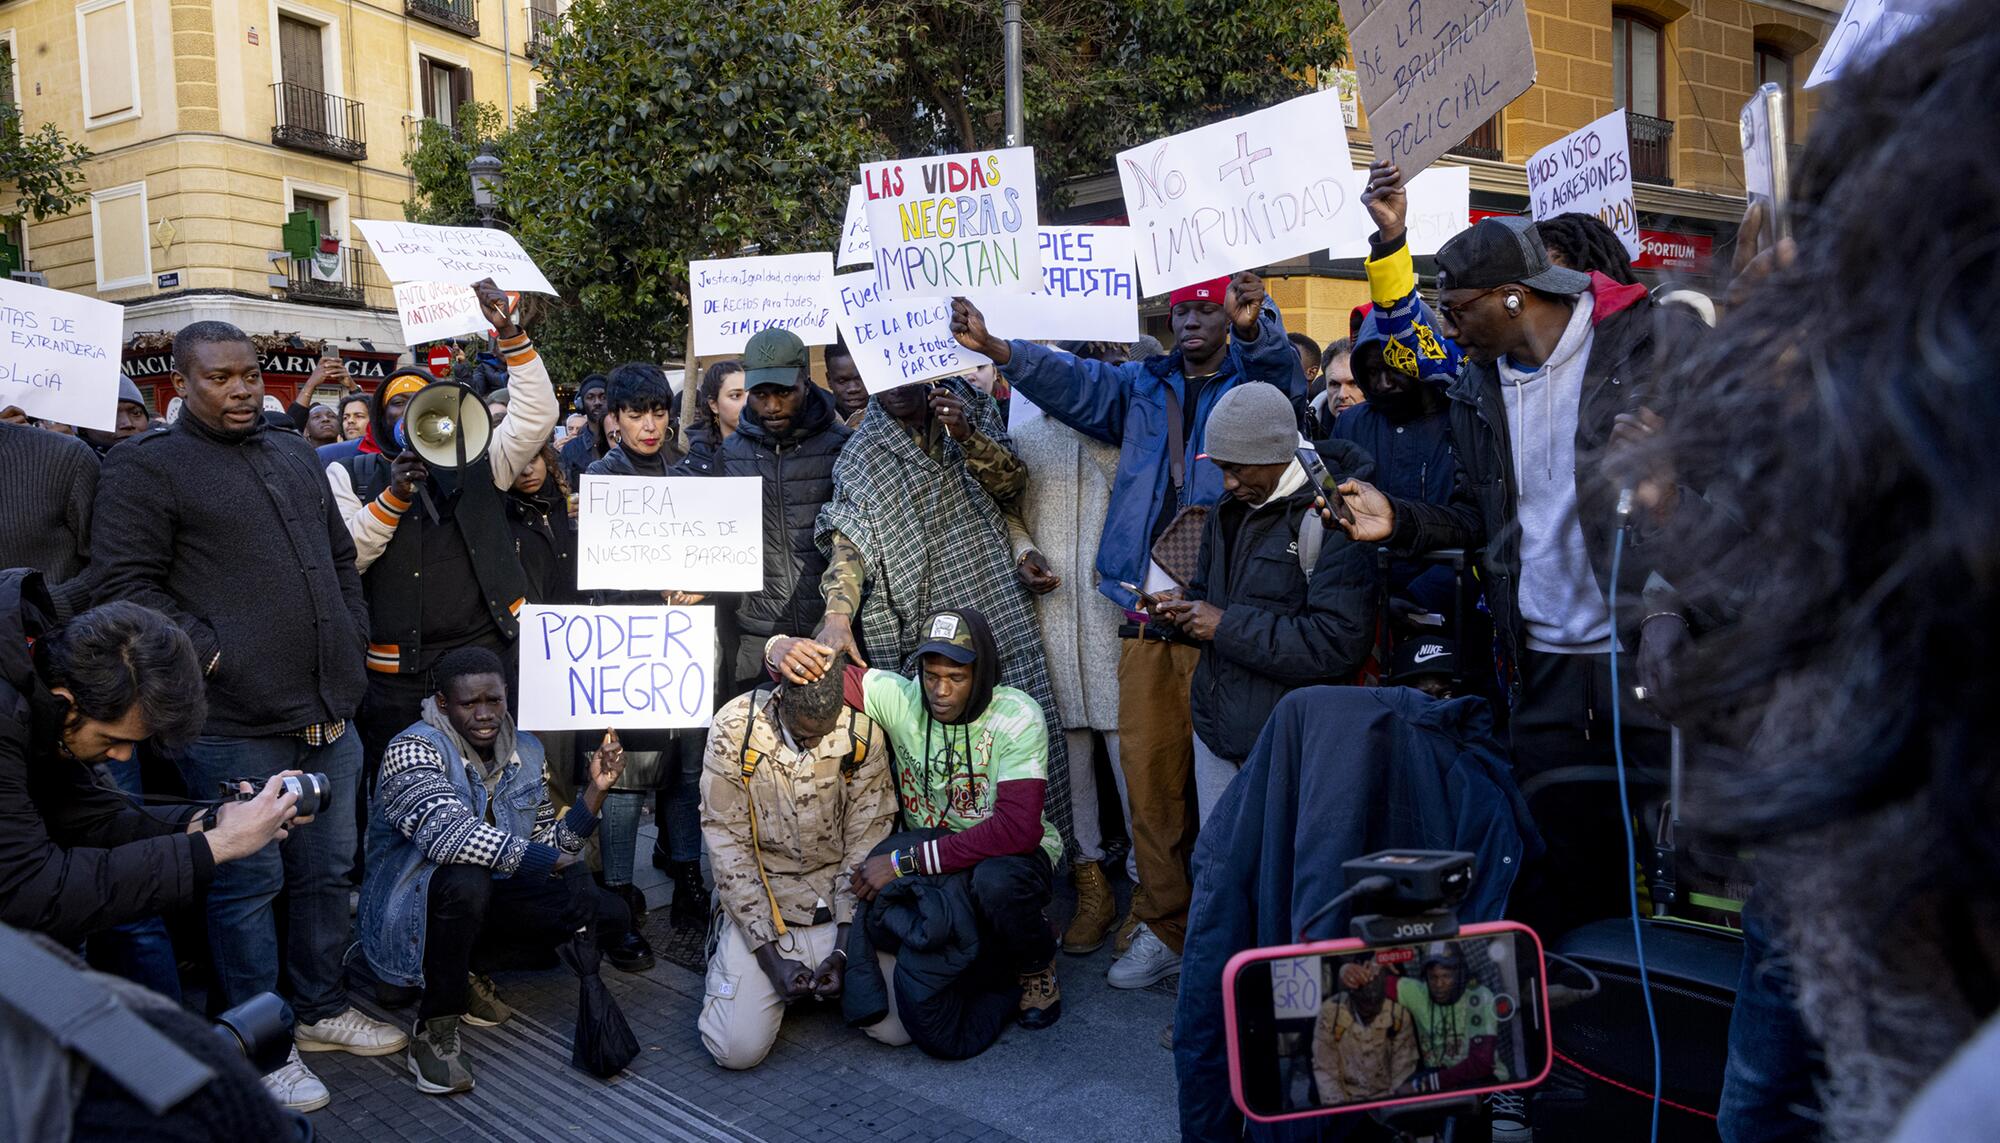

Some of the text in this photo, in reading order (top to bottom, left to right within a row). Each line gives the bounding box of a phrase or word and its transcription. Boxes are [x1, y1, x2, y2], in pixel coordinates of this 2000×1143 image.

[1395, 0, 1424, 49] LA
[865, 166, 905, 201] LAS
[921, 155, 1001, 194] VIDAS
[898, 187, 1022, 242] NEGRAS
[875, 238, 1020, 292] IMPORTAN
[50, 316, 75, 334] DE
[855, 323, 878, 344] DE
[882, 318, 900, 336] LA
[901, 353, 959, 378] PARTES
[590, 482, 676, 519] FUERA
[717, 520, 739, 536] DE
[587, 544, 672, 565] NUESTROS
[536, 610, 693, 662] PODER
[1418, 644, 1444, 656] NIKE
[568, 661, 705, 717] NEGRO
[1393, 922, 1435, 938] JOBY
